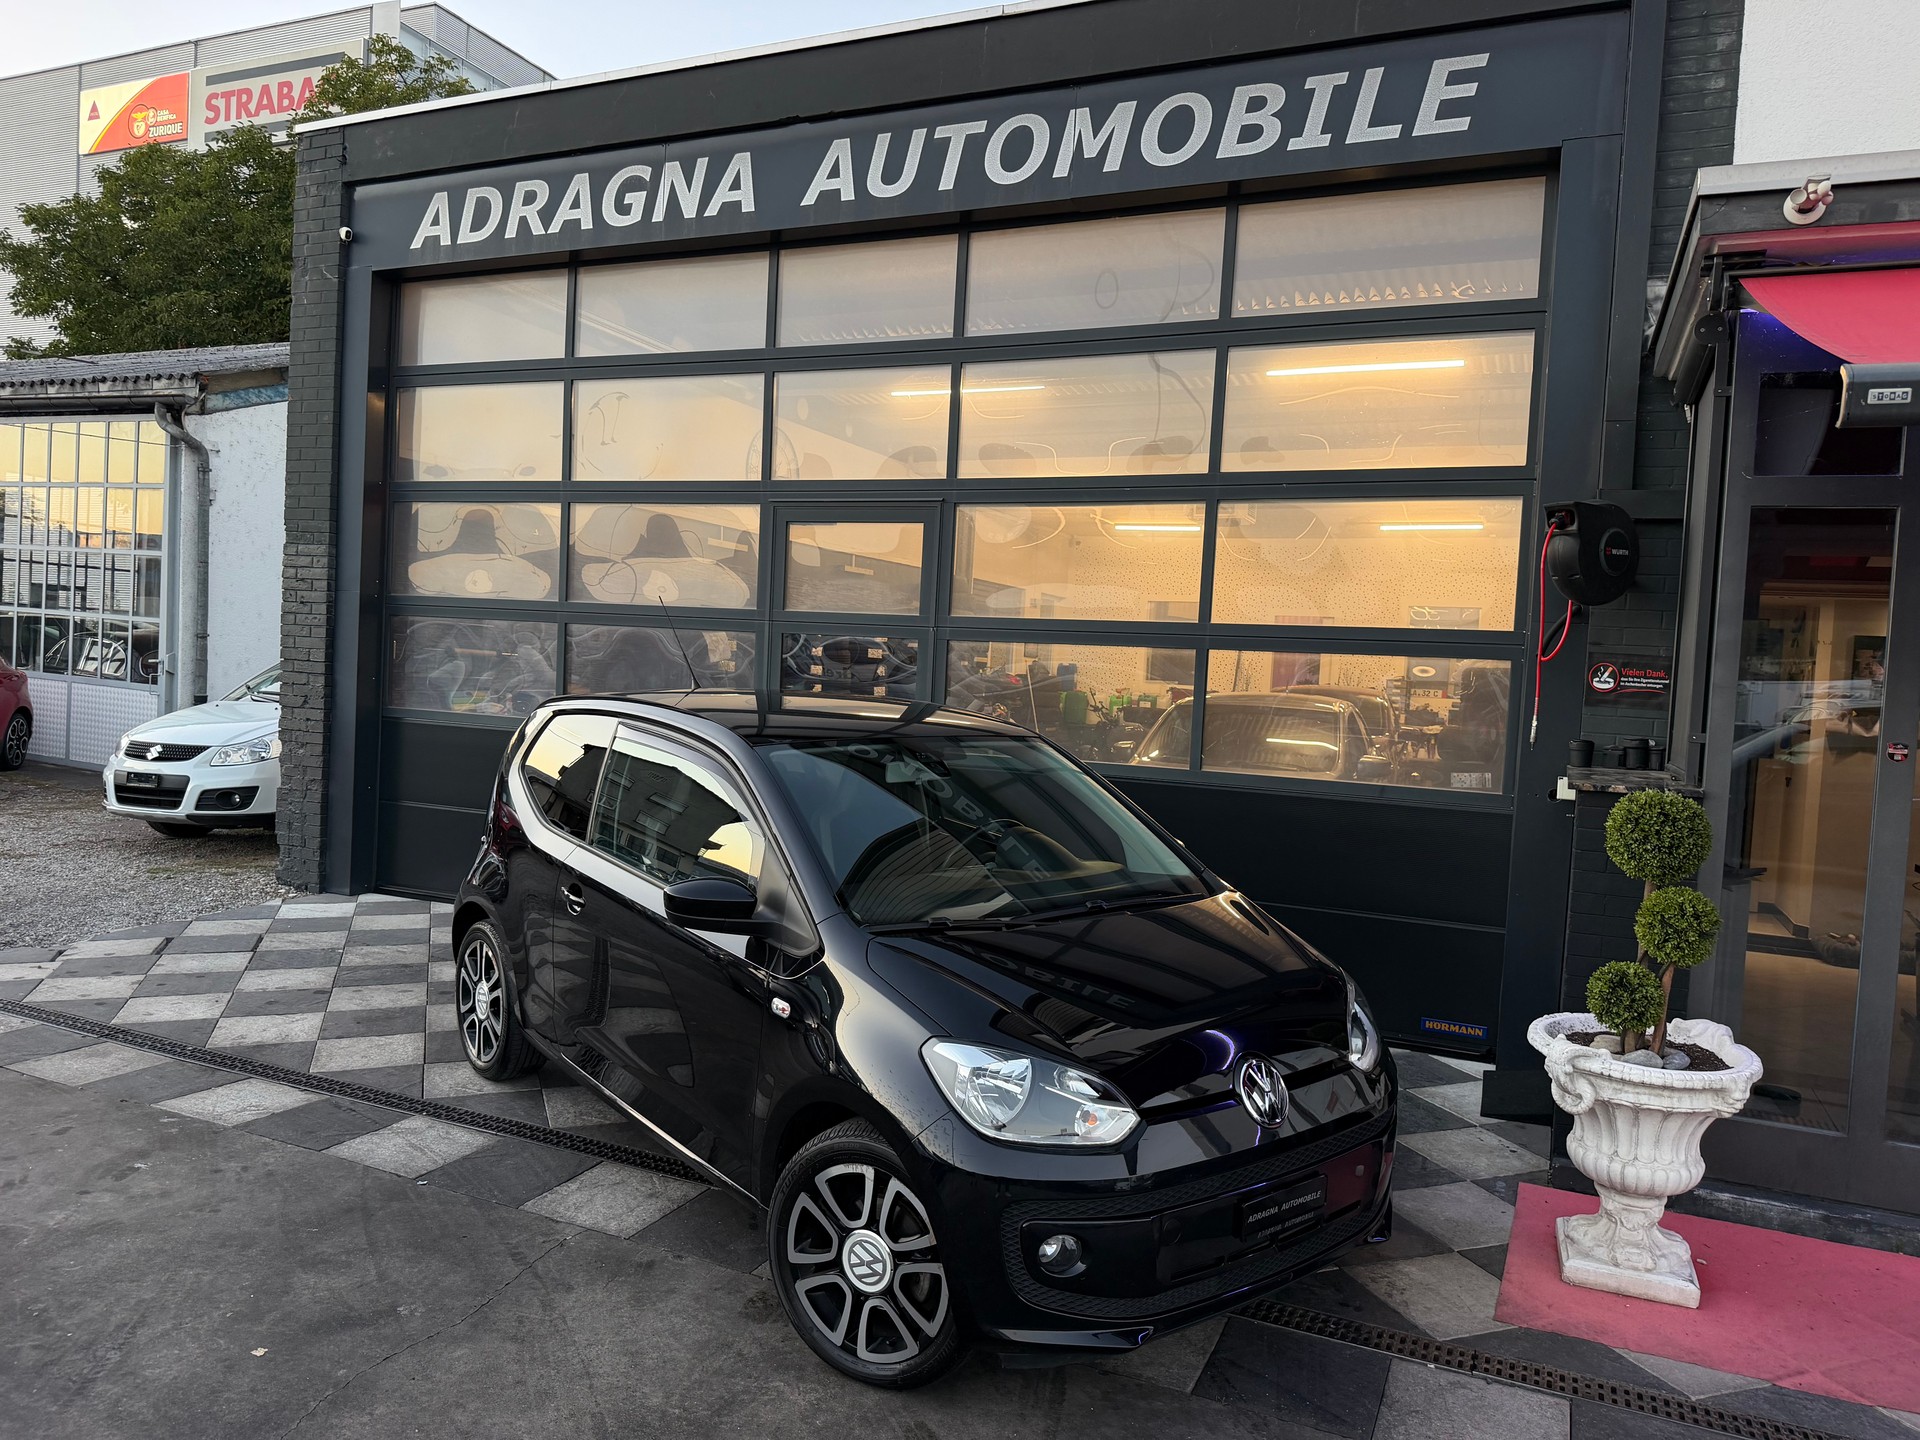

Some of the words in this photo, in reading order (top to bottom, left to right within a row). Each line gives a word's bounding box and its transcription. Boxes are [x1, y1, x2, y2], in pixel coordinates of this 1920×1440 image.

[204, 76, 317, 125] STRABA
[148, 122, 183, 138] ZURIQUE
[409, 151, 756, 249] ADRAGNA
[800, 52, 1490, 206] AUTOMOBILE
[1872, 392, 1908, 400] STOBAG
[1621, 668, 1644, 676] Vielen
[1646, 669, 1669, 679] Dank,
[1247, 1205, 1279, 1224] ADRAGNA
[1280, 1190, 1322, 1211] AUTOMOBILE
